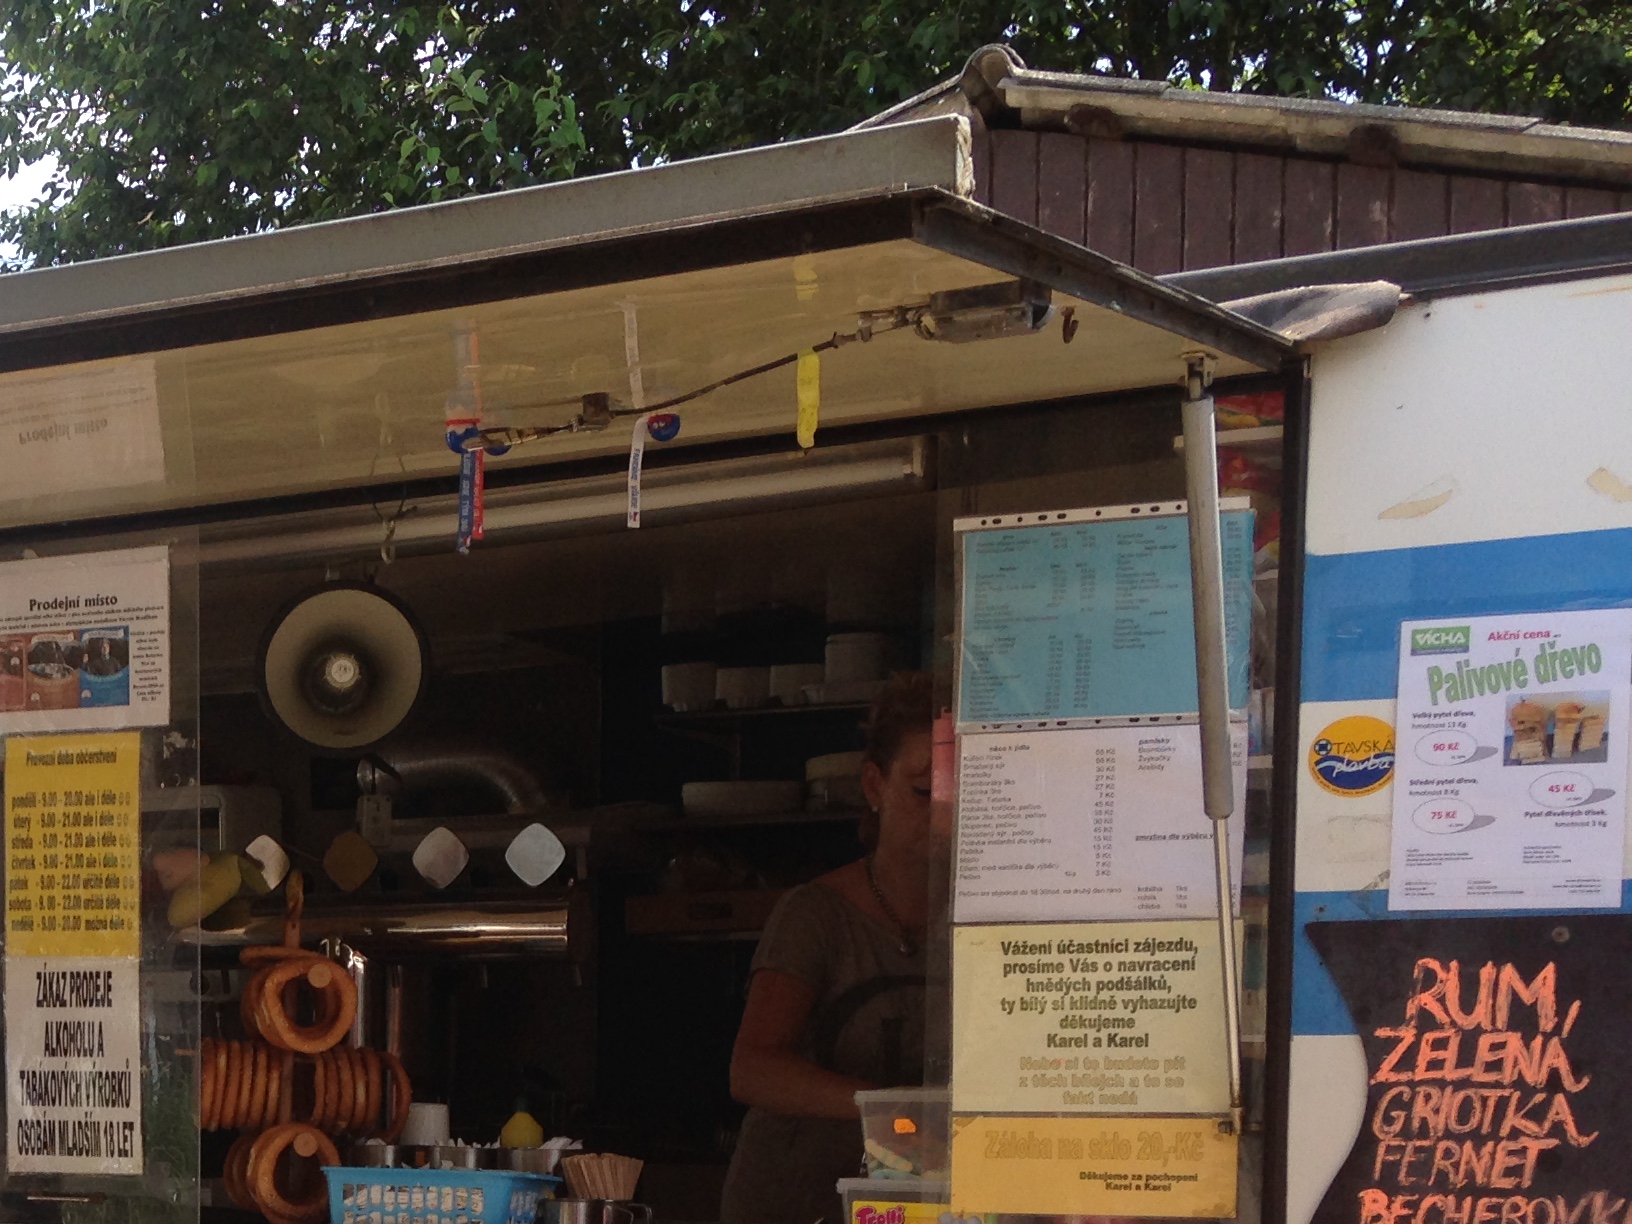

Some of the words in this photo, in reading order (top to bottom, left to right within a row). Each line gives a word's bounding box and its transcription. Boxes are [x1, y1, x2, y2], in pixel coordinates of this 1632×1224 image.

[29, 595, 81, 612] Prodejní
[84, 594, 118, 608] místo
[1488, 631, 1520, 642] Akční
[1523, 630, 1551, 640] cena
[1427, 647, 1528, 706] Palivové
[1534, 640, 1602, 685] dřevo
[1447, 742, 1459, 751] Kč
[1548, 785, 1560, 793] 45
[1563, 783, 1576, 792] Kč
[1431, 810, 1442, 819] 75
[1445, 809, 1457, 819] Kč
[1000, 940, 1053, 955] Vážení
[1056, 938, 1129, 954] účastníci
[1133, 937, 1198, 956] zájezdu,
[1003, 959, 1064, 978] prosíme
[1069, 958, 1098, 973] Vás
[1103, 961, 1113, 972] o
[1117, 956, 1197, 972] navracení
[36, 962, 67, 1008] ZÁKAZ
[69, 970, 112, 1008] PRODEJE
[1026, 977, 1091, 995] hnědých
[1096, 974, 1172, 995] podšálků,
[1000, 997, 1016, 1015] ty
[1020, 996, 1047, 1015] bílý
[1051, 995, 1065, 1011] si
[1069, 995, 1117, 1011] klidně
[1122, 995, 1198, 1013] vyhazujte
[1059, 1014, 1136, 1032] děkujeme
[44, 1020, 94, 1057] ALKOHOLU
[97, 1020, 104, 1057] A
[1047, 1033, 1088, 1048] Karel
[1092, 1036, 1102, 1048] a
[1107, 1033, 1149, 1048] Karel
[19, 1060, 83, 1107] TABÁKOVÝCH
[84, 1058, 131, 1108] VÝROBKŮ
[1372, 1086, 1600, 1147] GRIOTKA
[17, 1110, 56, 1156] OSOBÁM
[59, 1111, 101, 1157] MLADŠÍM
[104, 1121, 115, 1158] 18
[117, 1121, 134, 1158] LET
[1057, 1137, 1083, 1159] na
[1088, 1132, 1132, 1160] sklo
[1373, 1137, 1561, 1190] FERNET
